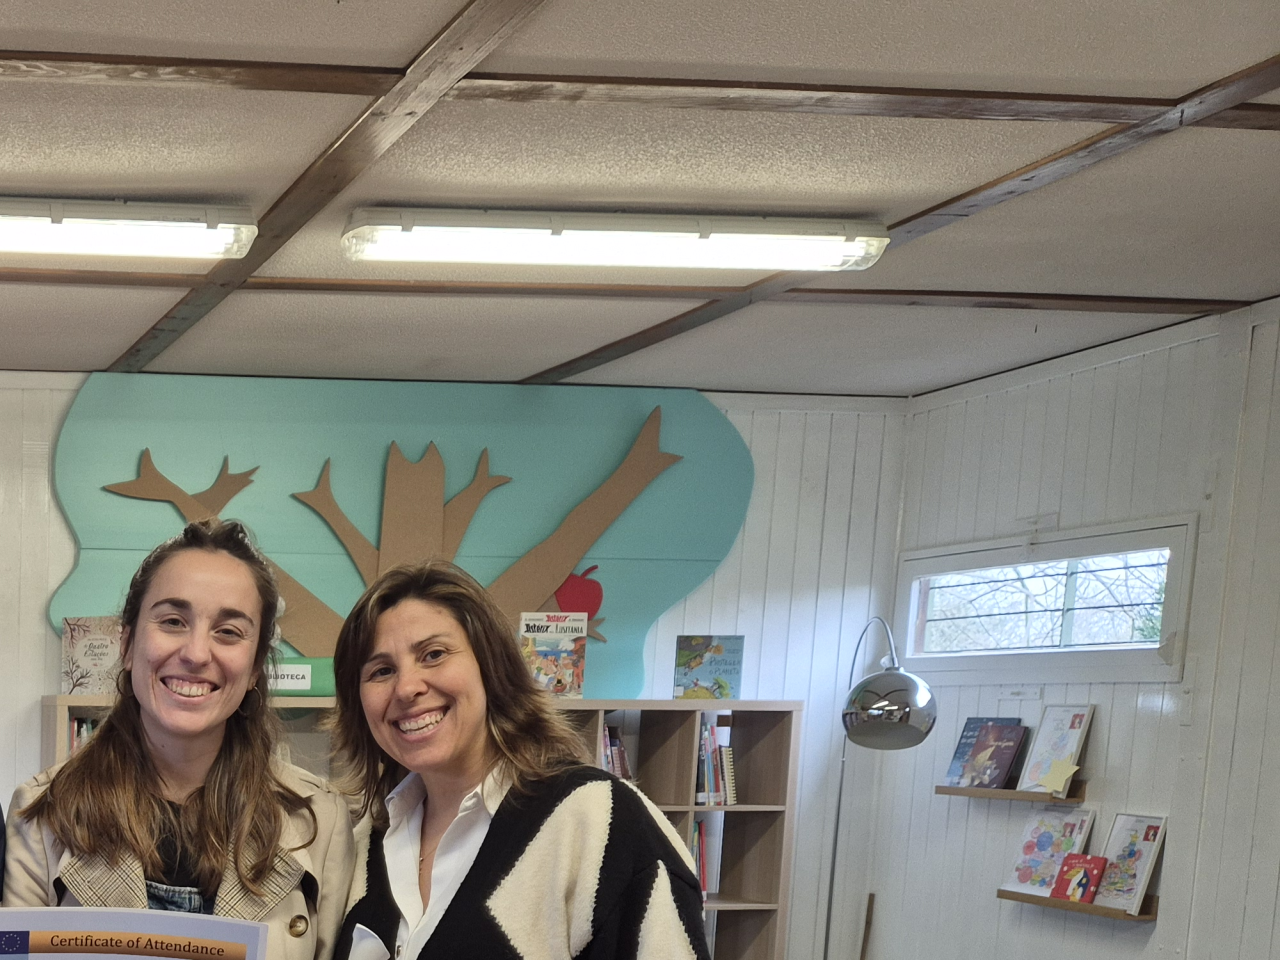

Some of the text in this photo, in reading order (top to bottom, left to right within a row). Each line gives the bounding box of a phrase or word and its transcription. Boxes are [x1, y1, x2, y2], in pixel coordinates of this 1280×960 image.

[524, 623, 551, 634] Astérix
[50, 934, 224, 956] Certificate of Attendance
